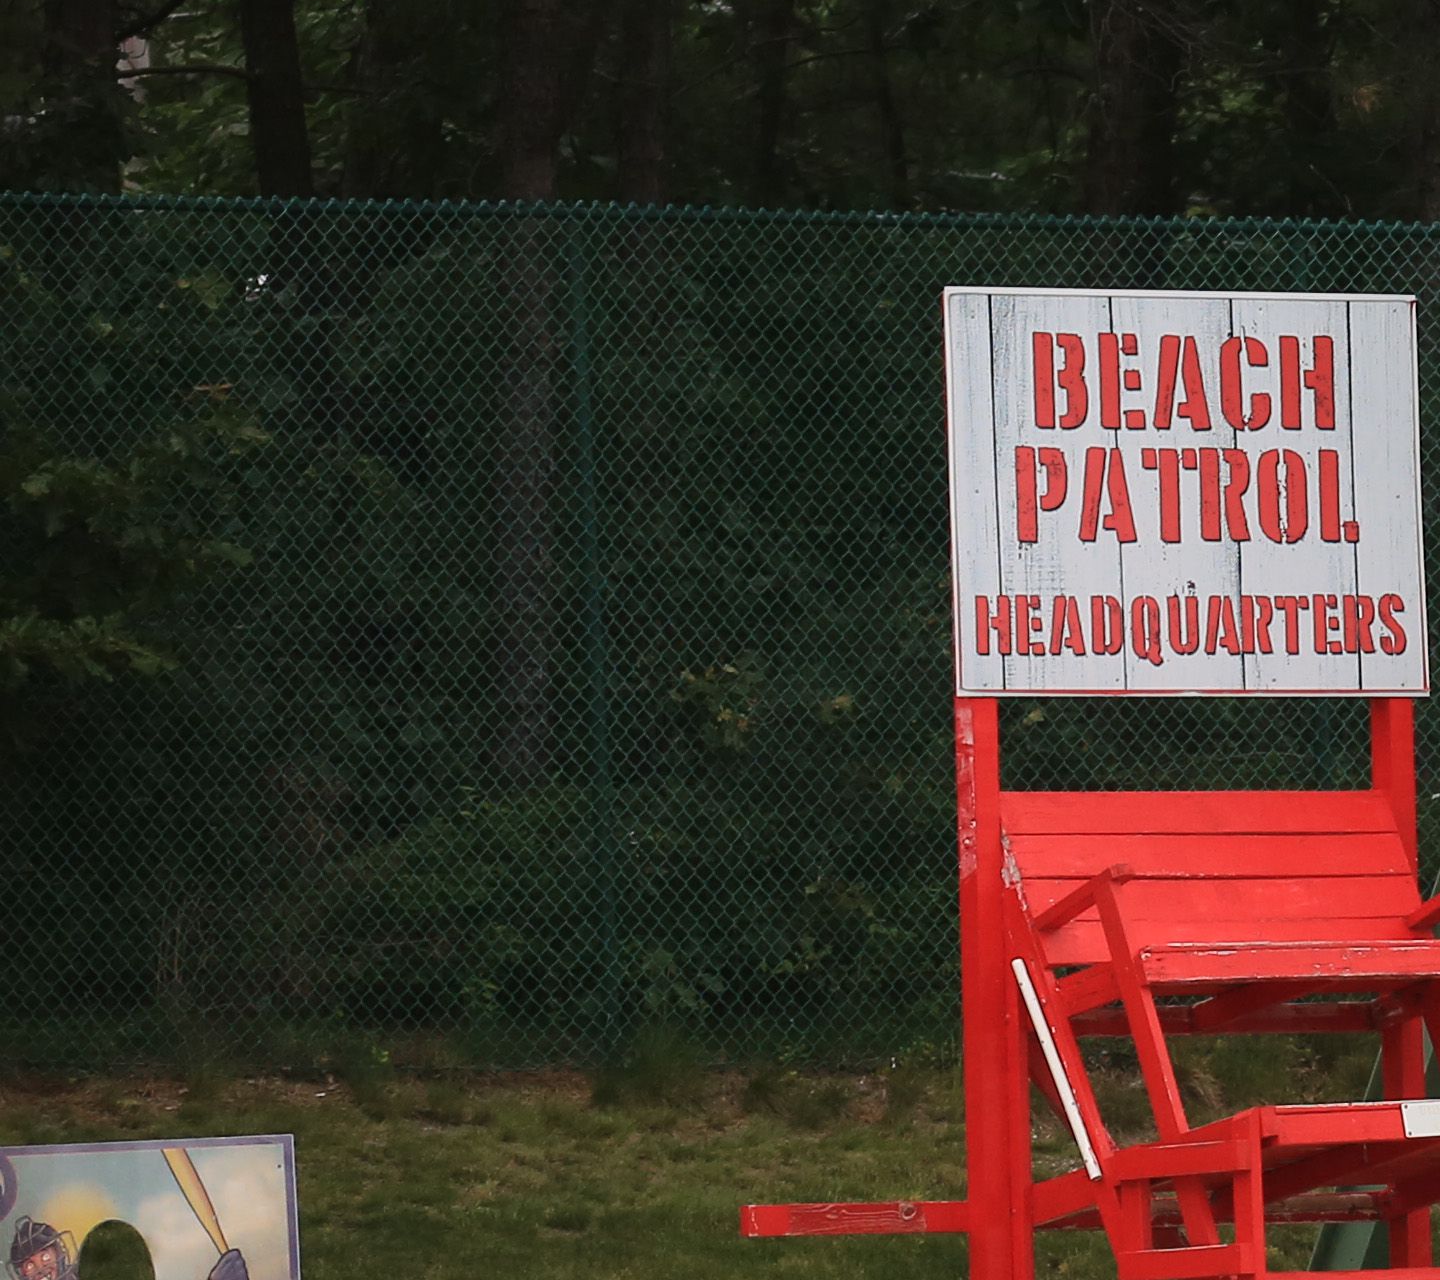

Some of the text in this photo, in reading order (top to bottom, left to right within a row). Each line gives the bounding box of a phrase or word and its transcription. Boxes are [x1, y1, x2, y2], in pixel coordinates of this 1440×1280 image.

[1032, 332, 1335, 431] BEACH
[1014, 446, 1360, 545] PATROL
[974, 593, 1407, 667] HEADQUARTERS
